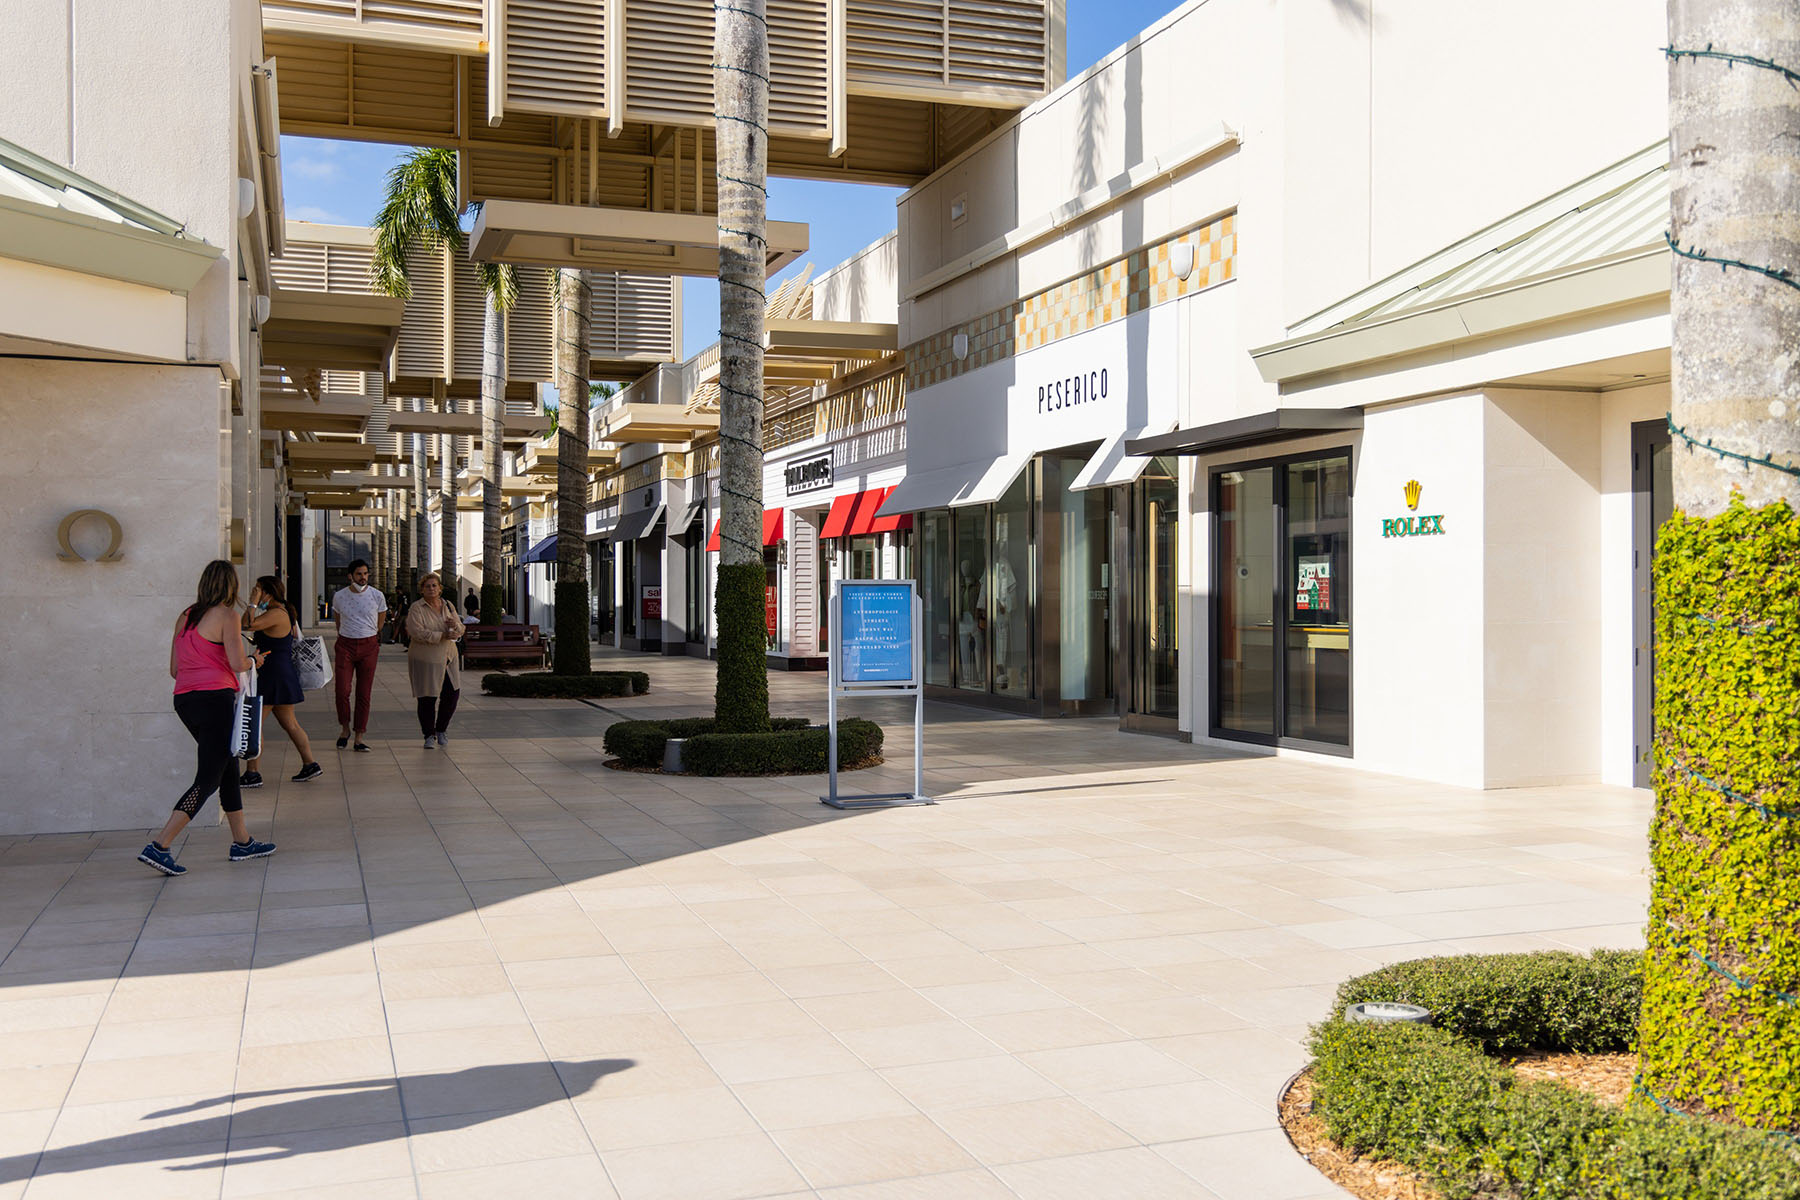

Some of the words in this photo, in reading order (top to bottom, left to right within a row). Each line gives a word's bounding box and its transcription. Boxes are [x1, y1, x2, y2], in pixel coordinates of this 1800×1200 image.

[1038, 368, 1108, 414] PESERICO
[1381, 514, 1446, 538] ROLEX
[647, 588, 661, 597] sal
